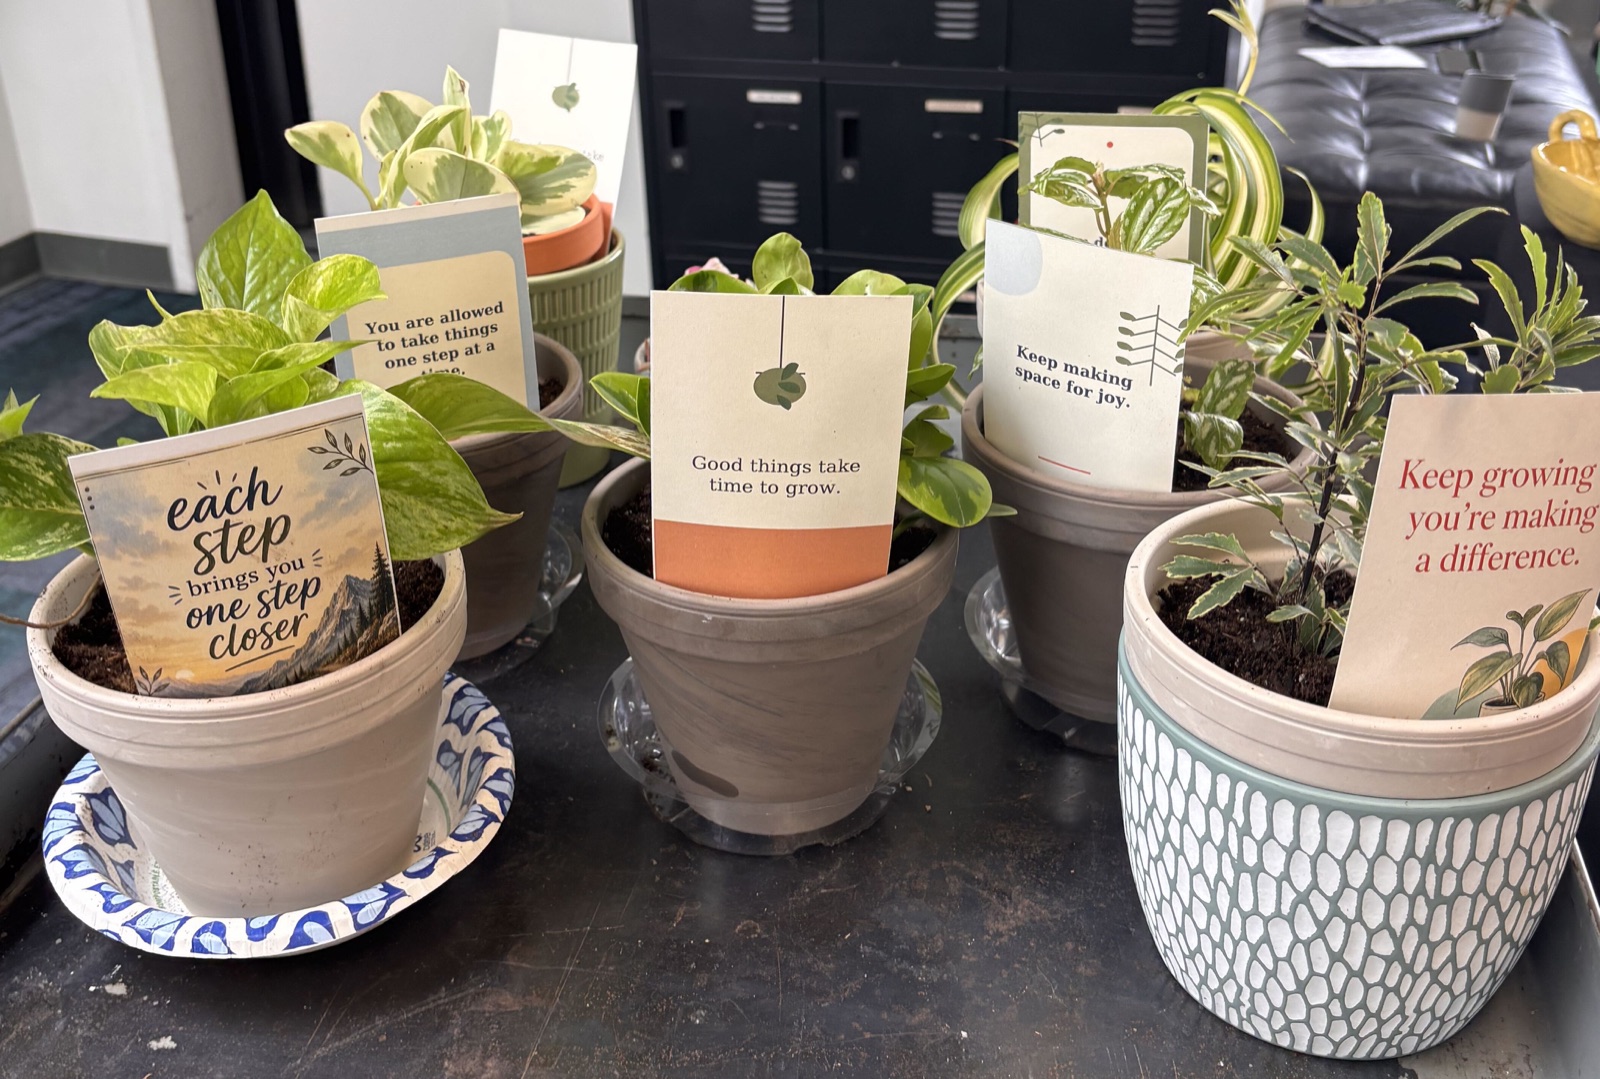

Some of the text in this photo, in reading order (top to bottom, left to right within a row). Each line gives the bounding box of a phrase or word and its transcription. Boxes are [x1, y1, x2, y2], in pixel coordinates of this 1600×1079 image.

[365, 301, 504, 335] You are allowed
[376, 322, 499, 352] to take things
[385, 342, 496, 369] one step at a
[1016, 344, 1133, 391] Keep making
[1015, 366, 1131, 409] space for joy.
[691, 455, 861, 477] Good things take
[1398, 458, 1598, 498] Keep growing
[167, 466, 284, 532] each
[709, 477, 841, 498] time to grow.
[1501, 498, 1600, 534] making
[193, 513, 292, 576] step
[1415, 542, 1581, 573] a difference.
[186, 556, 305, 598] brings you
[186, 575, 322, 630] one step
[208, 612, 310, 660] closer
